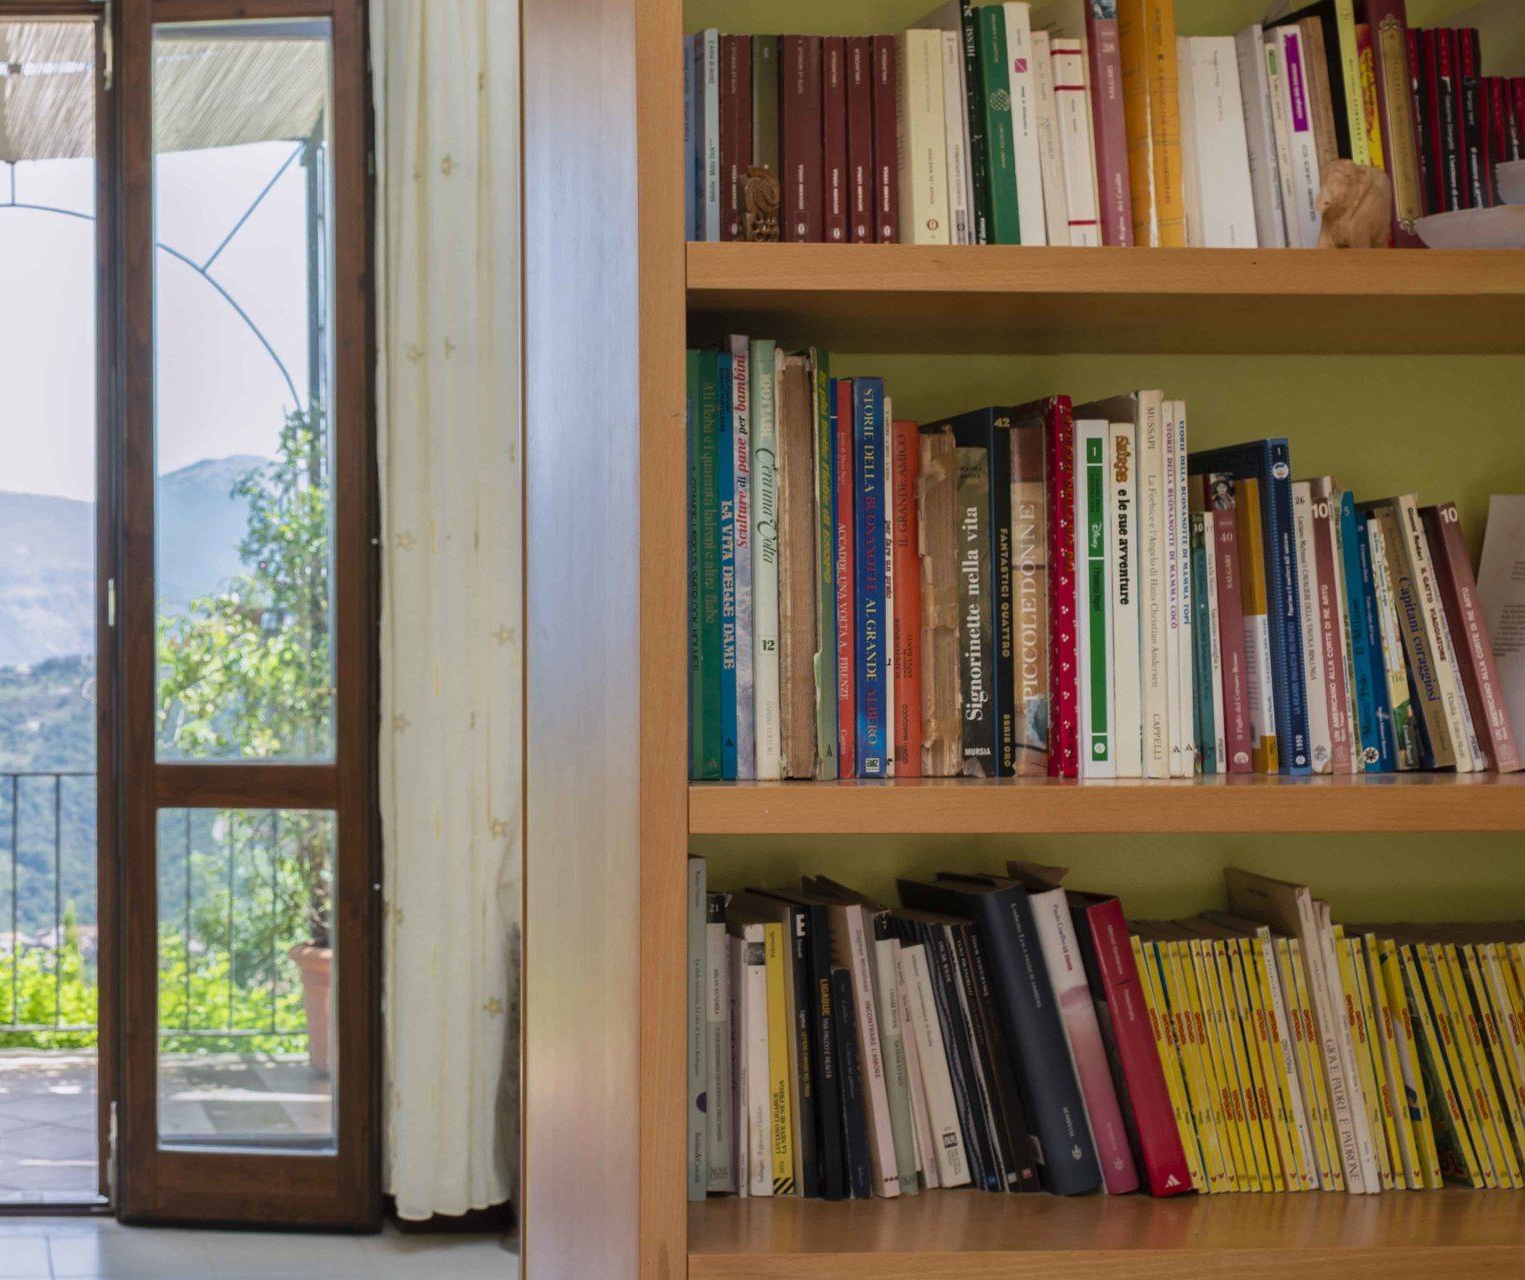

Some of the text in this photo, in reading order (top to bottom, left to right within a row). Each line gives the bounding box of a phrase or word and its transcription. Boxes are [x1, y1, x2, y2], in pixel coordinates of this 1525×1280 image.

[733, 353, 748, 549] Sculture di pane per bambini
[994, 418, 1010, 428] 42
[897, 433, 909, 547] IL GRANDE AMICO
[1118, 488, 1130, 607] e le sue avventure
[1311, 502, 1329, 518] 10
[721, 500, 735, 670] LA VITA DELLE DAME
[863, 388, 879, 746] STORIE DELLA BUONANOTTE AL GRANDE ALBERO
[961, 505, 988, 721] Signorinette nella vita
[1001, 528, 1011, 658] FANTASTICI QUATTRO
[1020, 504, 1037, 702] PICCOLE DONNE
[1420, 564, 1447, 663] IL GATTO VIAGGIATORE
[761, 639, 775, 652] 12
[1397, 576, 1442, 703] Capitani coraggiosi
[964, 747, 991, 756] MURSIA
[821, 978, 829, 1017] LIGABUE
[1332, 1077, 1347, 1114] PADRE
[1340, 1129, 1359, 1181] PADRONE
